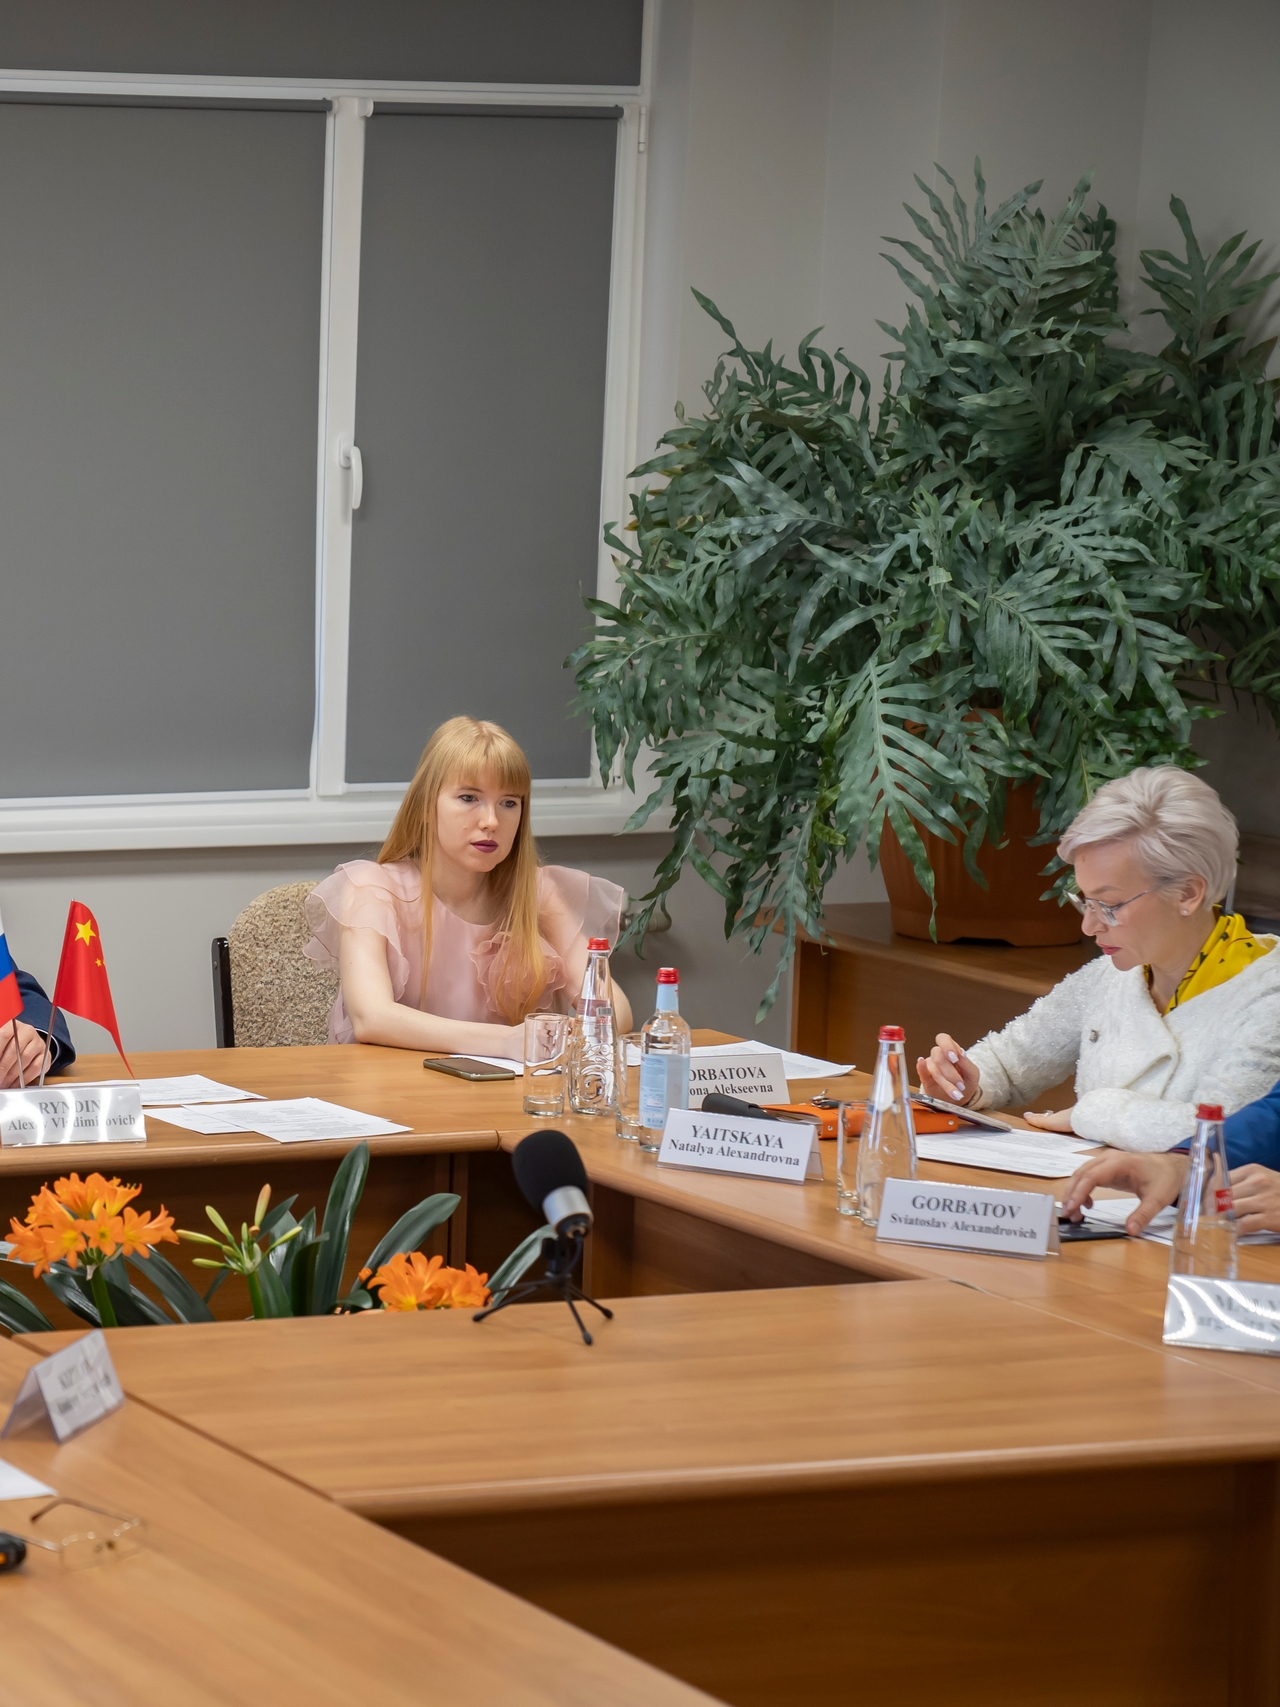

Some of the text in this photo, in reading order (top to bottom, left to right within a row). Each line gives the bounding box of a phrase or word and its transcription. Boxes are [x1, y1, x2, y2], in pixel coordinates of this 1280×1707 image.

[689, 1066, 767, 1082] ORBATOVA
[713, 1083, 774, 1095] Alekseevna
[38, 1099, 102, 1115] RYNDIN
[8, 1114, 136, 1132] Alexy Vldimiovich
[691, 1124, 784, 1150] YAITSKAYA
[668, 1138, 800, 1166] Natalya Alexandrovna
[911, 1195, 1022, 1220] GORBATOV
[889, 1213, 1038, 1240] Sviatoslav Alexandrovich
